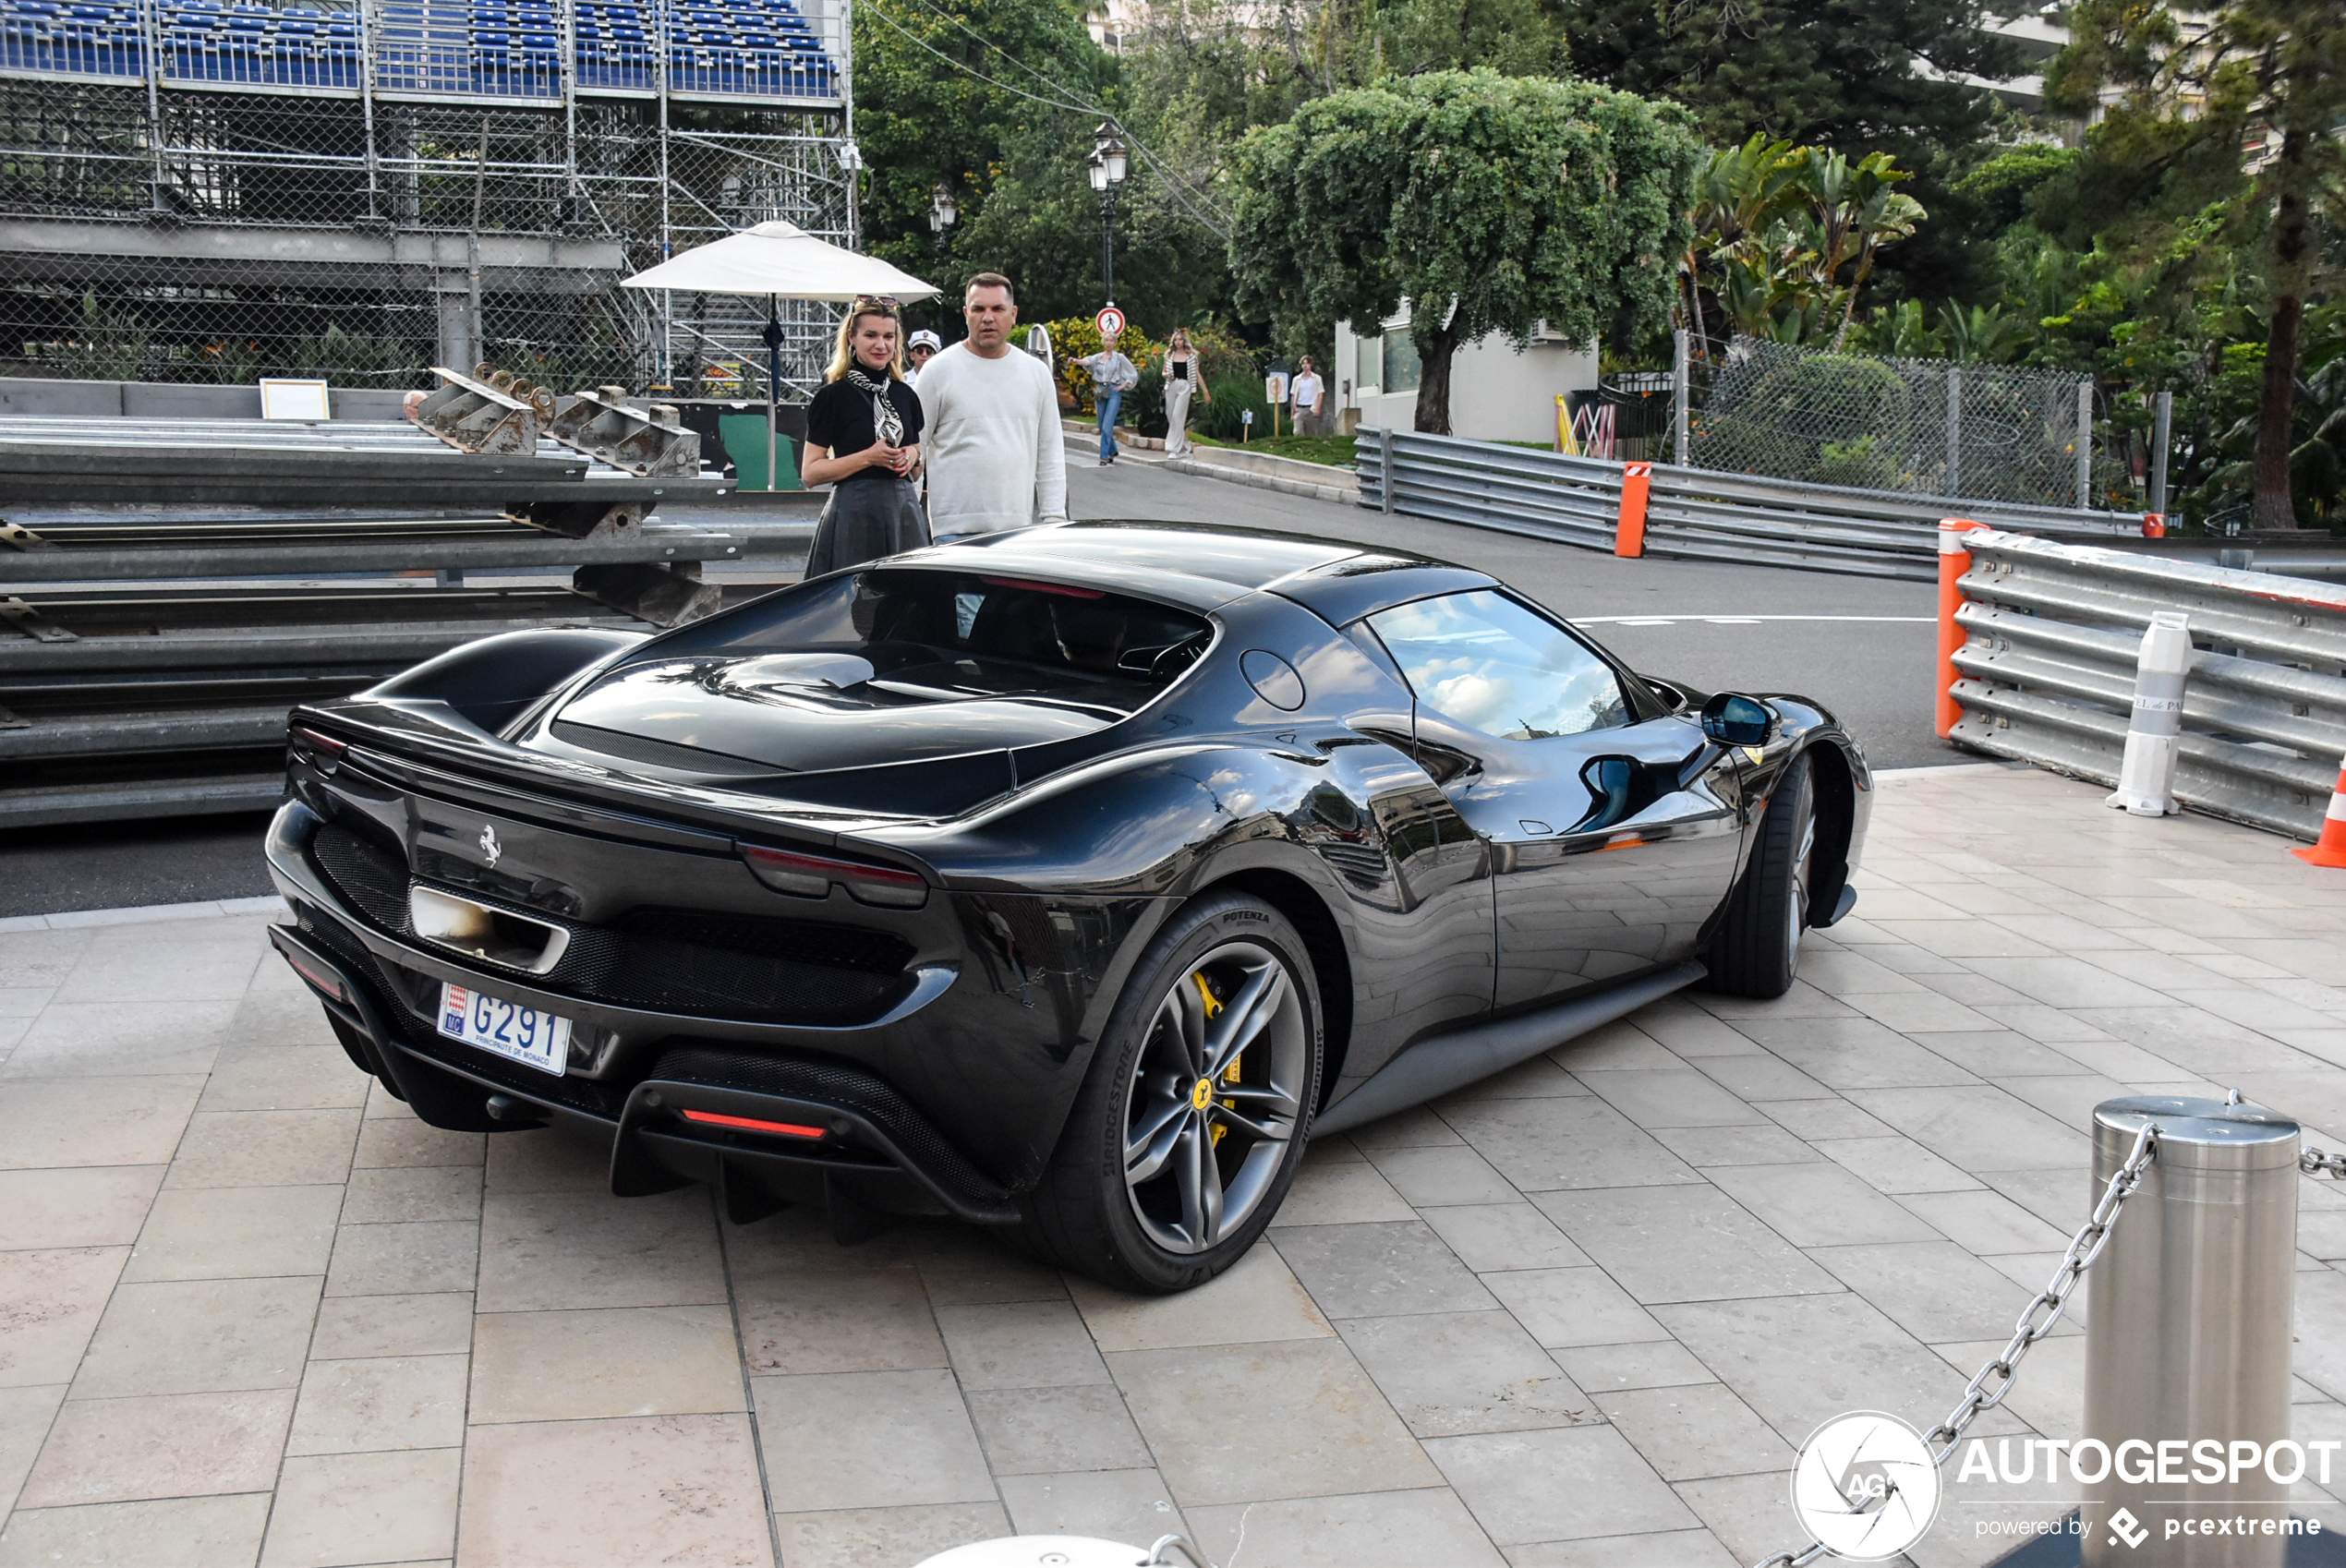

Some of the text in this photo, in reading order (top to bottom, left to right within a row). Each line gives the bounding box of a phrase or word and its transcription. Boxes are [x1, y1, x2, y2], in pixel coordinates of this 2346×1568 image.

[2135, 697, 2149, 709] EL
[1223, 911, 1270, 924] POTENZA
[447, 1016, 461, 1032] MC
[474, 993, 557, 1056] G291
[475, 1033, 550, 1067] PRINCIPAUTE DE MONACO
[1104, 1040, 1134, 1177] BRIDGESTONE
